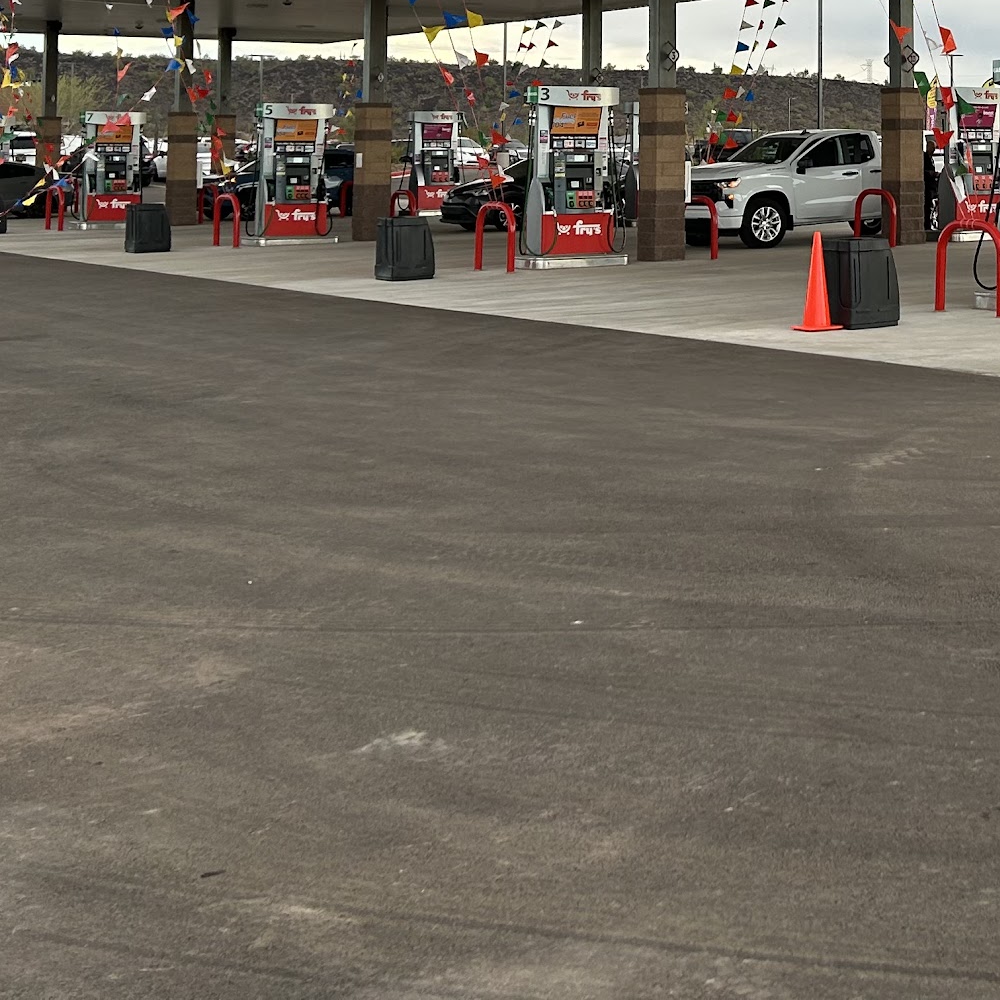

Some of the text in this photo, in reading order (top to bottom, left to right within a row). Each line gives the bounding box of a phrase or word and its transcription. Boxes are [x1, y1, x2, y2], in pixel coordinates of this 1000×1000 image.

[541, 88, 550, 101] 3
[265, 105, 273, 115] 5
[87, 113, 93, 121] 7
[110, 199, 131, 210] fry
[291, 209, 317, 222] fry's
[573, 220, 602, 236] fry's
